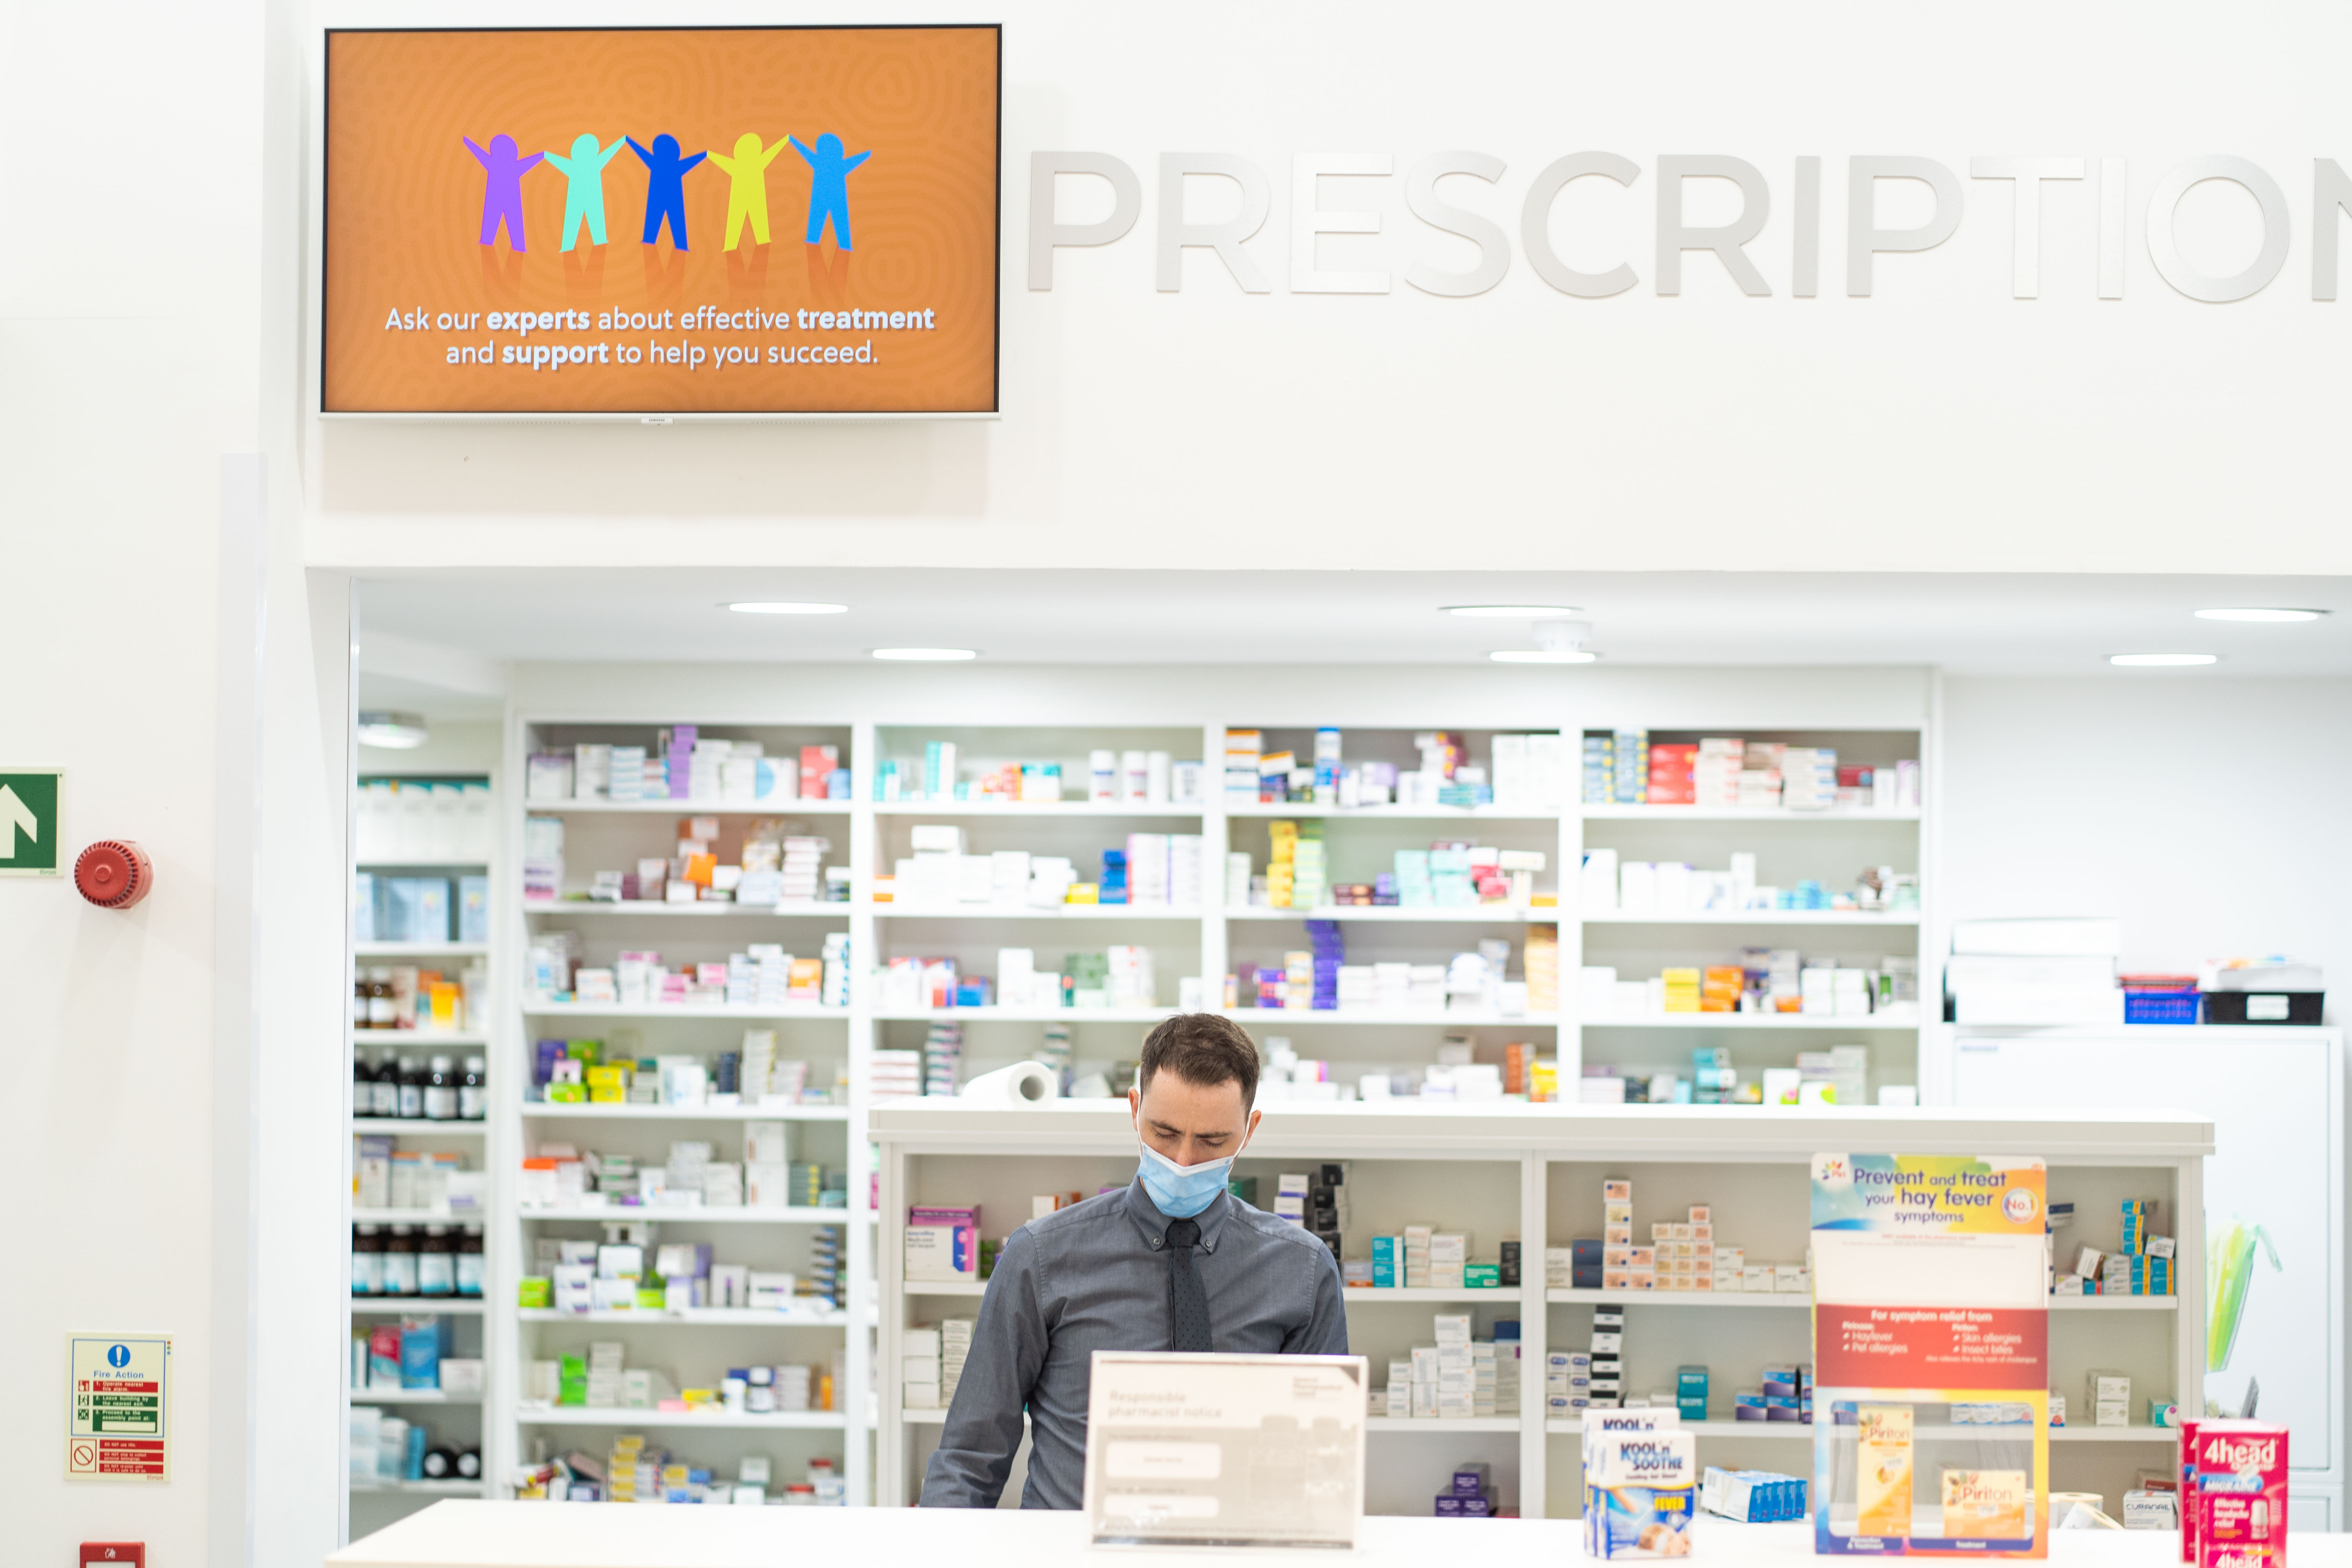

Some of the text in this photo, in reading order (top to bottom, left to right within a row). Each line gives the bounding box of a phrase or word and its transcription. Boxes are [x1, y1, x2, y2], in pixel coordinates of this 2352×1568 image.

[385, 305, 935, 337] Ask our experts about effective treatment
[446, 339, 878, 370] and support to help you succeed.
[1854, 1167, 2006, 1187] Prevent and treat
[1865, 1188, 1994, 1209] your hay fever
[2007, 1199, 2034, 1211] No.1
[1895, 1211, 1964, 1225] symptoms
[1871, 1309, 1993, 1323] For symptom relief from
[1110, 1389, 1186, 1403] Responsible
[1108, 1406, 1222, 1420] pharmacist notice
[1869, 1426, 1909, 1439] Piriton
[2204, 1437, 2276, 1464] 4head
[1633, 1455, 1682, 1470] SOOTHE
[1963, 1485, 2012, 1500] Piriton
[1654, 1496, 1685, 1511] FEVER
